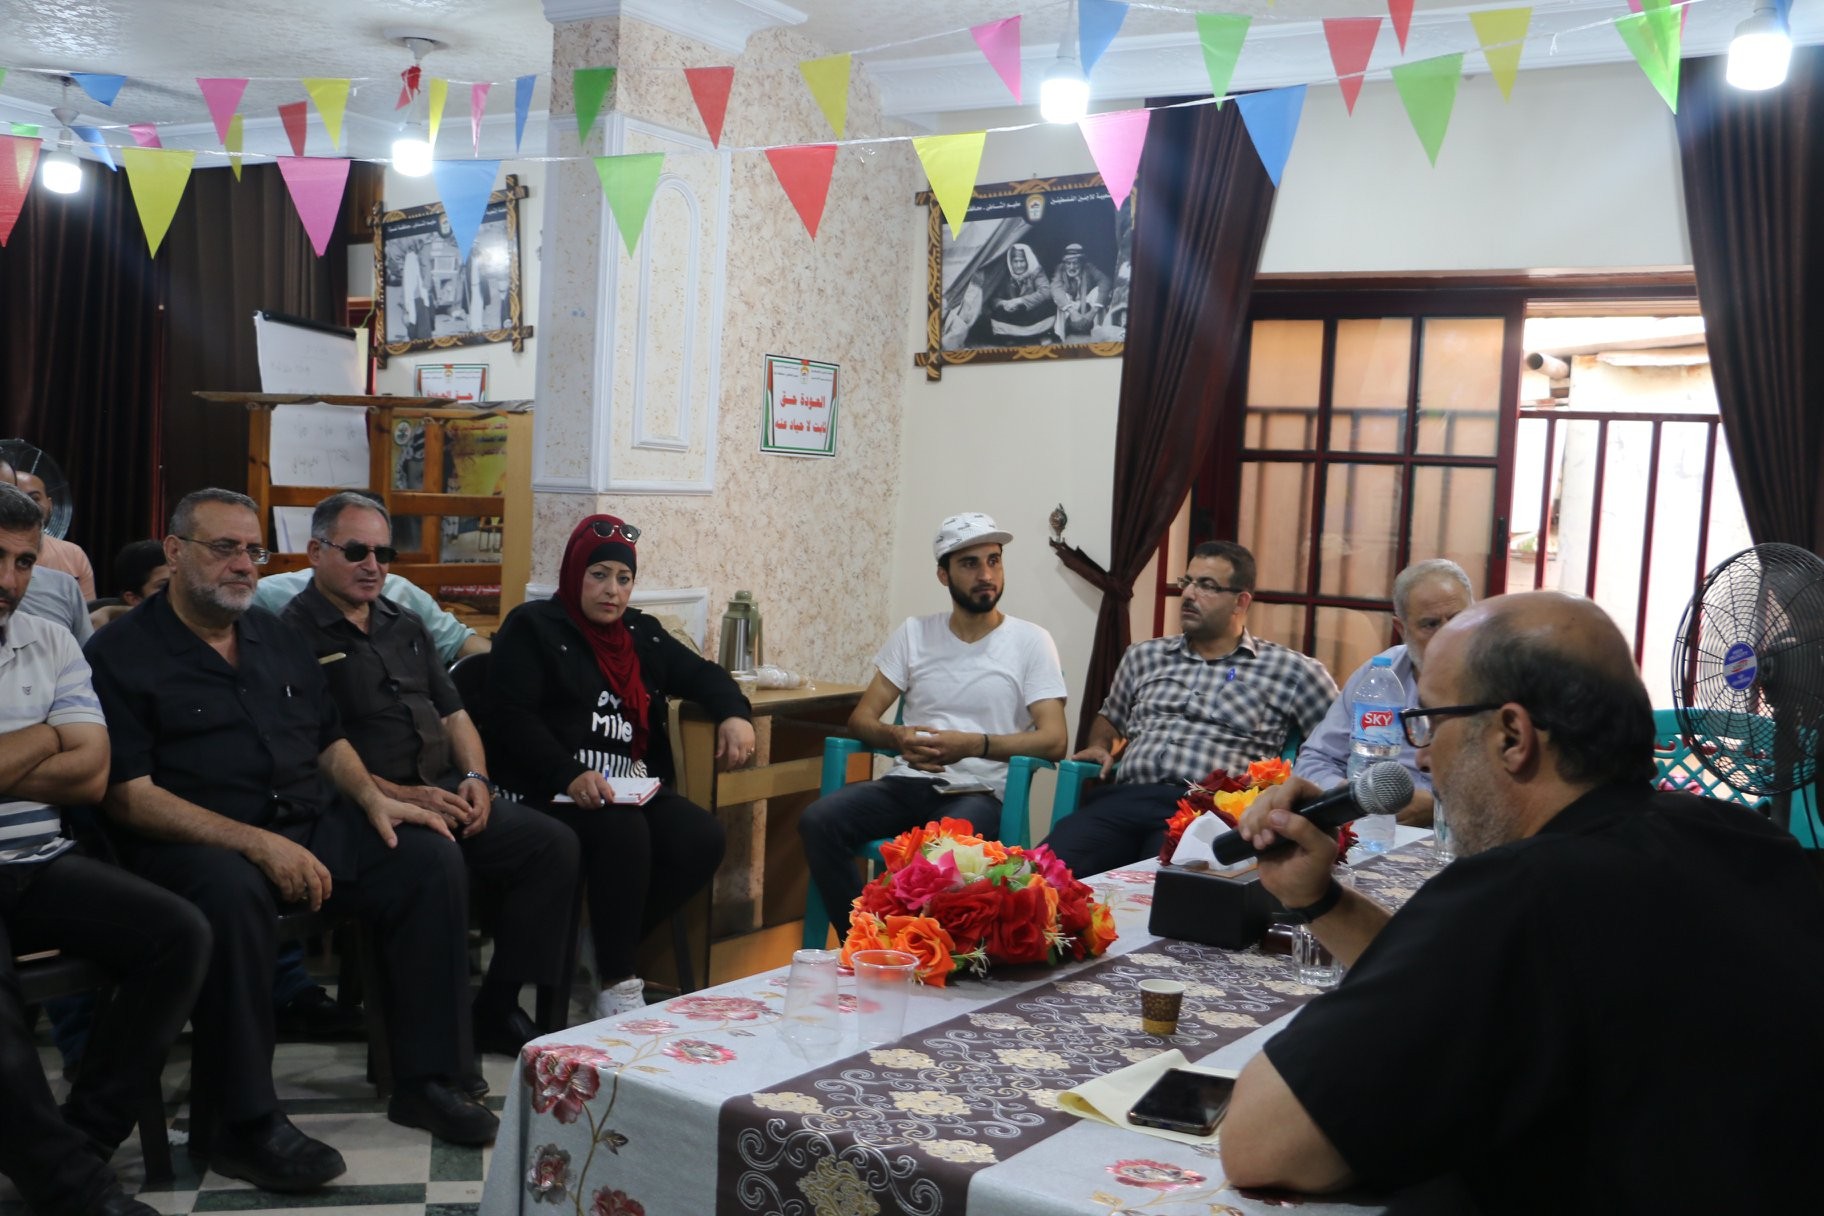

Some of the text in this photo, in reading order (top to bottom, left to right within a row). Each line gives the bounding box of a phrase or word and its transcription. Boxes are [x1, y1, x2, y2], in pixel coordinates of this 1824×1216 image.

[780, 390, 825, 410] العودة حق
[592, 712, 632, 742] Mile
[1365, 713, 1391, 725] SKY
